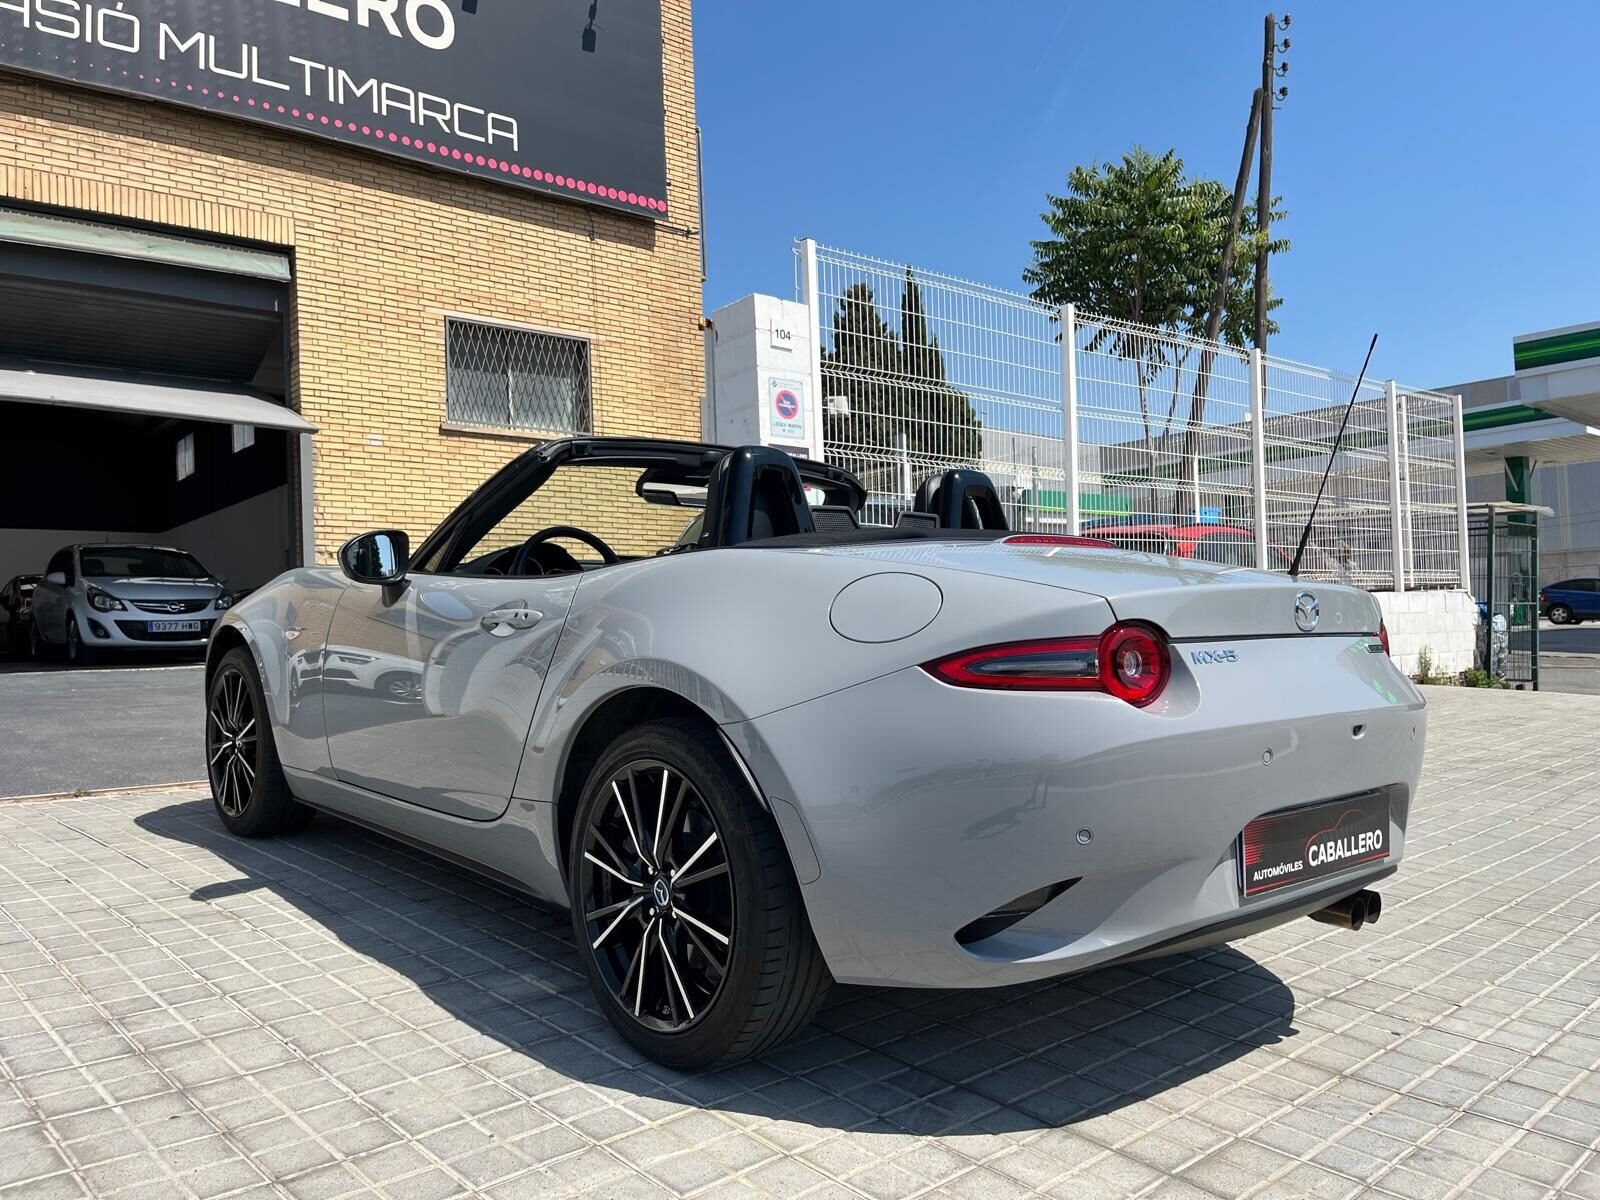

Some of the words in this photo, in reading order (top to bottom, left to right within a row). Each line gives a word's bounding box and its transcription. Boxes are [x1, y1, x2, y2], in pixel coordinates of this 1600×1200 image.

[159, 22, 519, 152] MULTIMARCA
[775, 328, 792, 341] 104
[154, 622, 179, 631] 9377
[1191, 649, 1239, 665] MX-5
[1253, 860, 1304, 881] AUTOMÓVILES
[1308, 829, 1383, 867] CABALLERO
